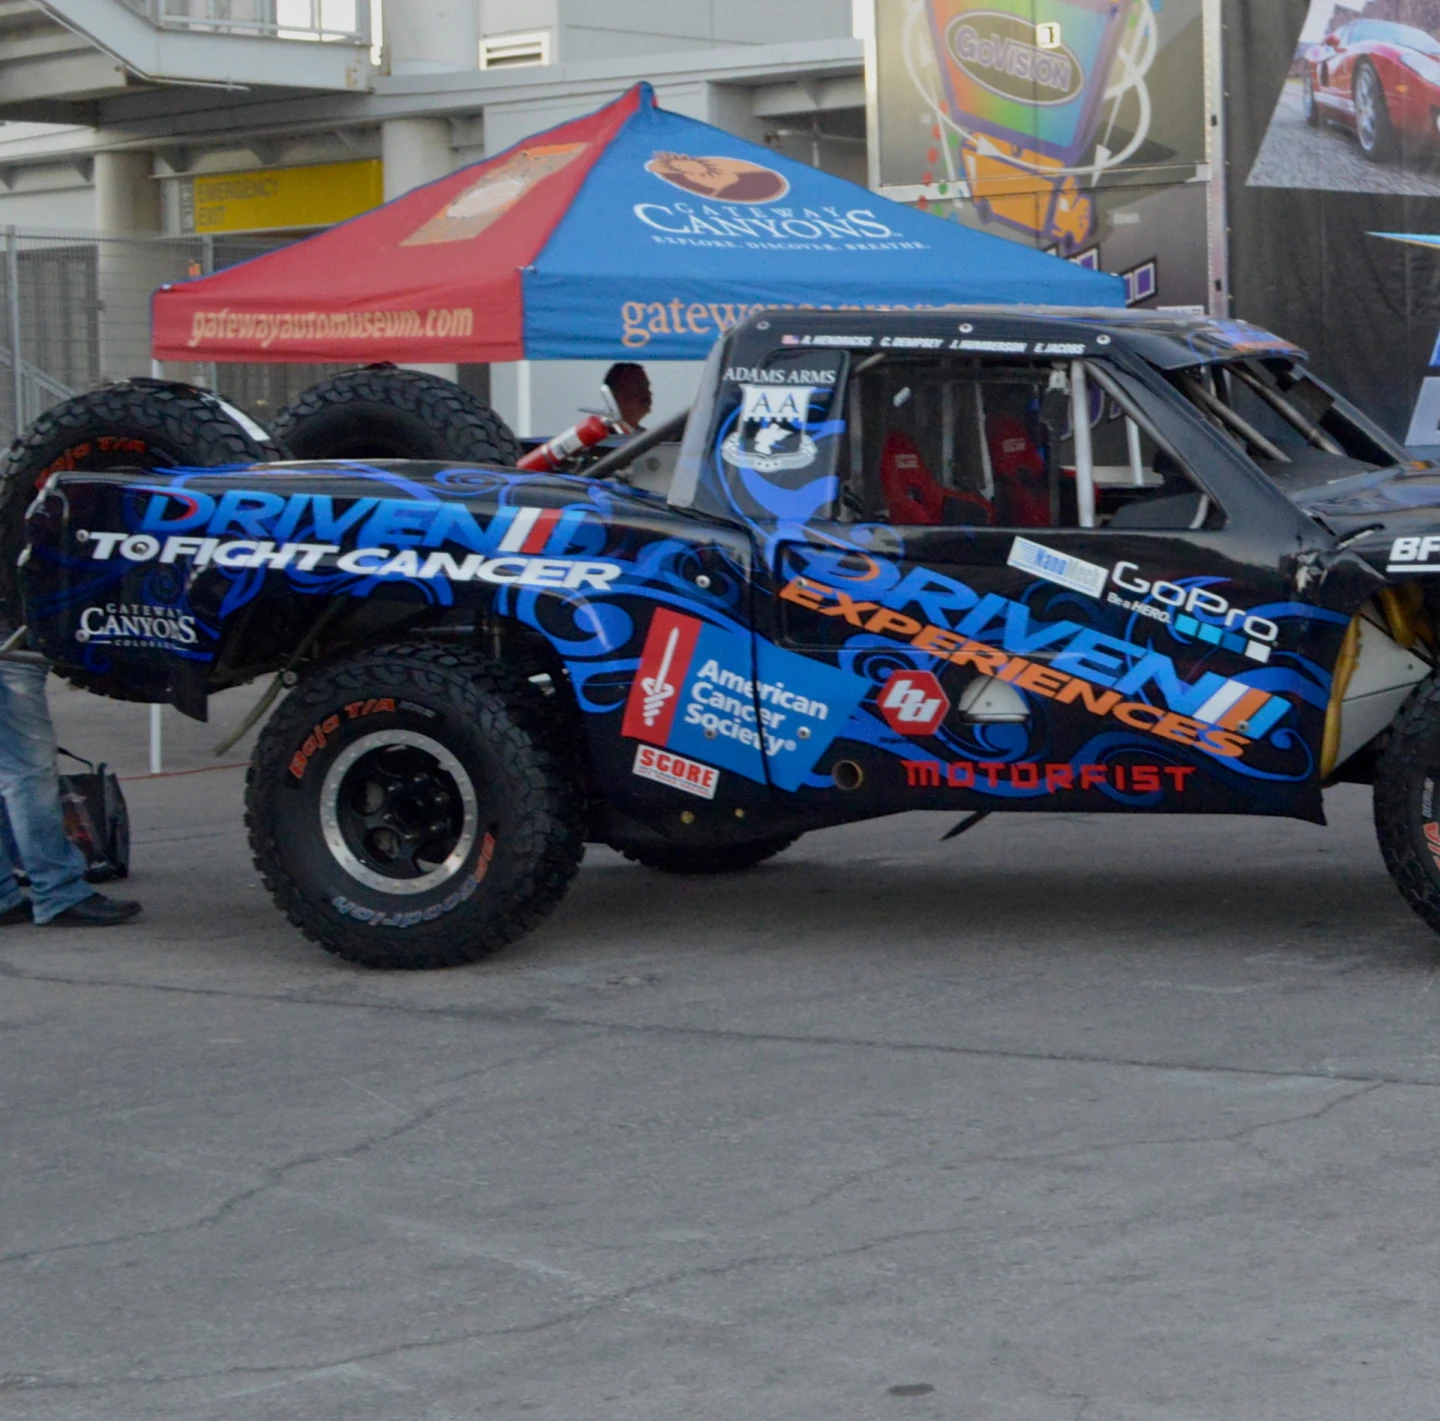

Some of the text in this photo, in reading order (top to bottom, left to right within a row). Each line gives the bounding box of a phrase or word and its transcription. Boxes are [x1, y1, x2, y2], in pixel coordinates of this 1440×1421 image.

[633, 202, 893, 239] CANYONS
[673, 202, 844, 219] GATEWAY
[722, 367, 836, 384] ADAMS ARMS
[88, 532, 622, 590] TO FIGHT CANCER
[1111, 560, 1279, 641] GoPro
[80, 607, 195, 643] CANYONS
[780, 576, 1252, 758] EXPERIENCES
[691, 681, 786, 730] Cancer
[697, 659, 829, 721] American
[640, 748, 716, 788] SCORE
[903, 760, 1196, 792] MOTORFIST
